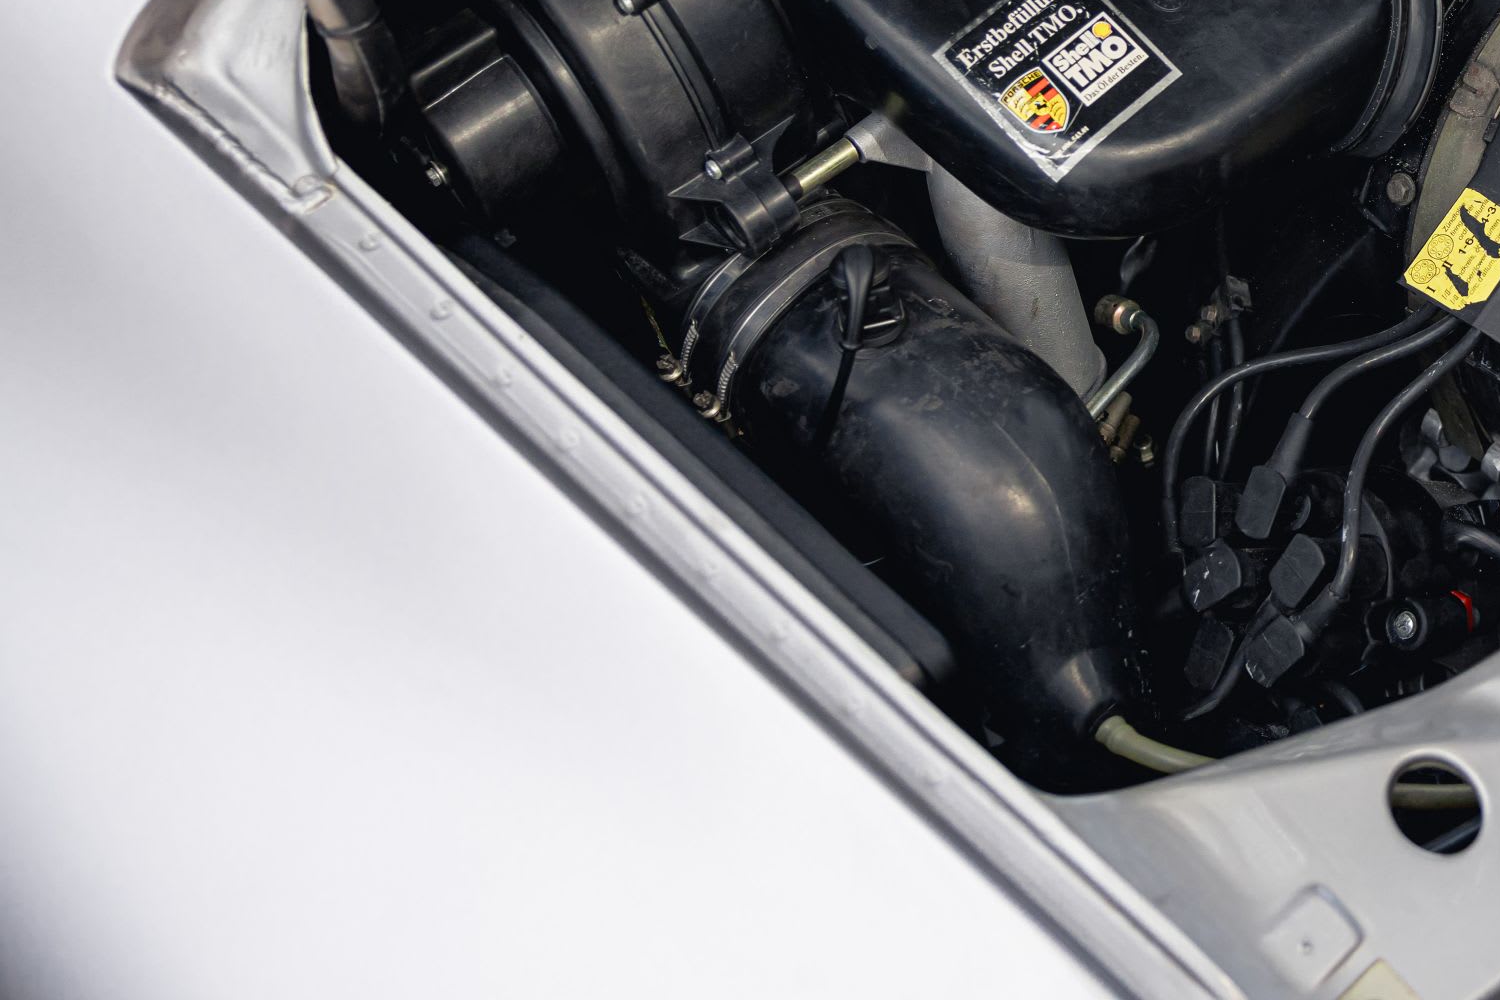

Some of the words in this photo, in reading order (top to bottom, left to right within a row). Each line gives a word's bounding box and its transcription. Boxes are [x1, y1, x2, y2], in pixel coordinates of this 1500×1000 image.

[987, 37, 1033, 79] Shell
[1027, 2, 1082, 47] TMO.
[1050, 29, 1101, 72] Shell
[1064, 35, 1123, 89] TMO
[1002, 70, 1041, 101] PORSCHE
[1084, 88, 1100, 101] Das
[1096, 78, 1109, 90] Öl
[1105, 71, 1120, 83] der
[1117, 53, 1144, 74] Besten.
